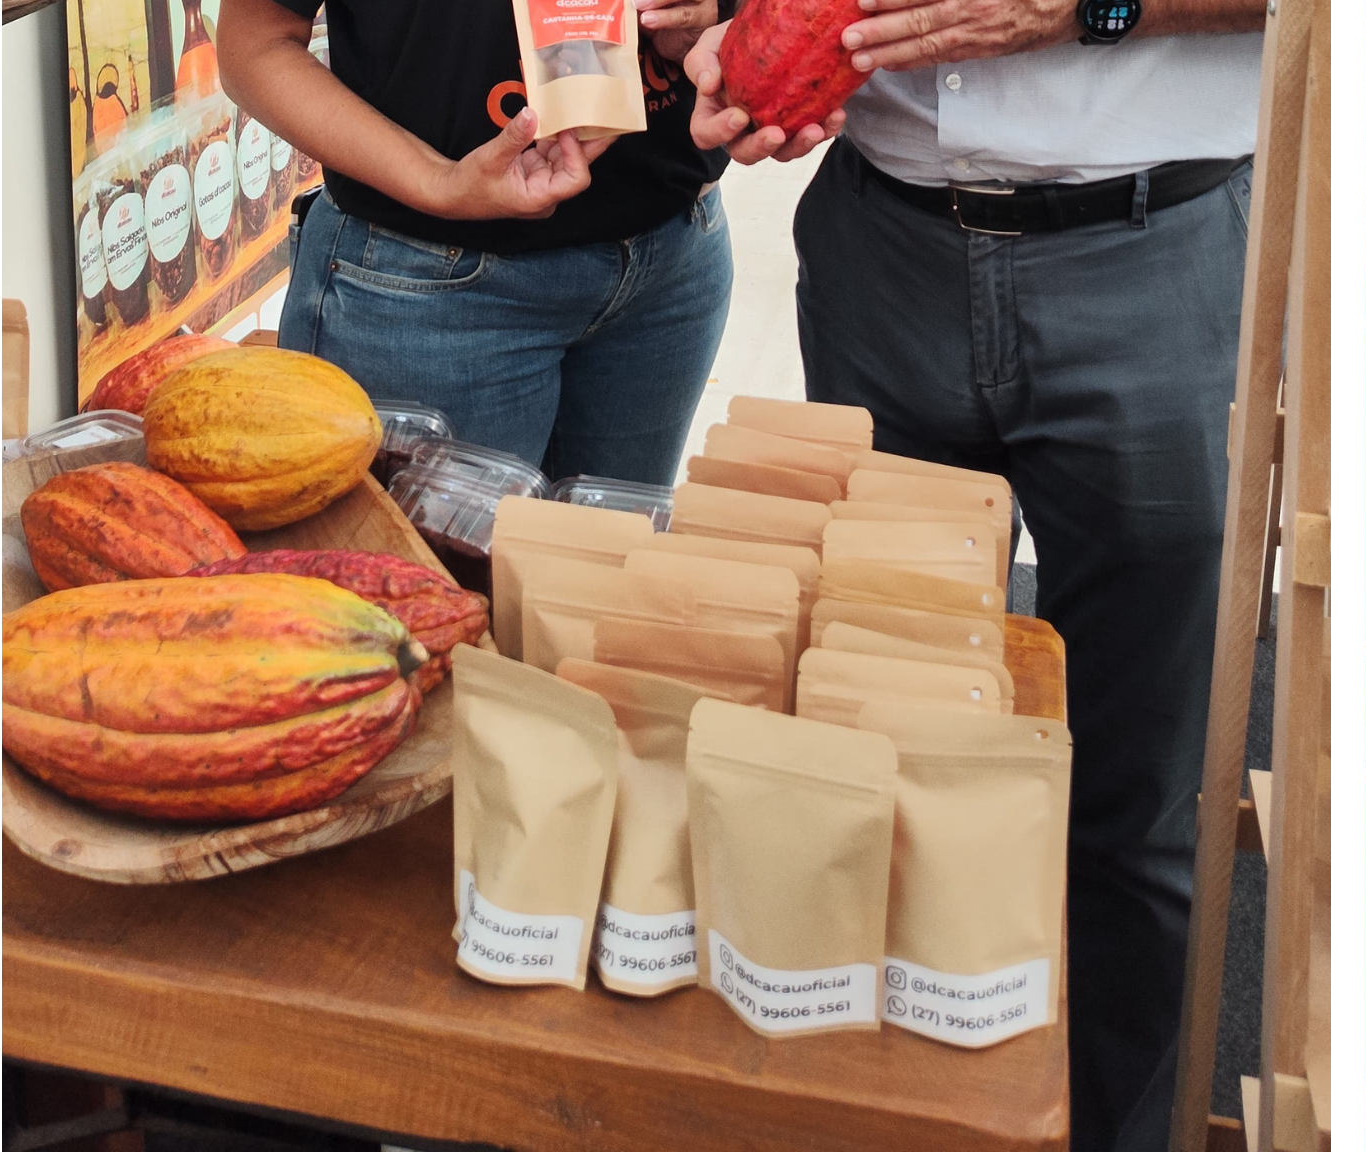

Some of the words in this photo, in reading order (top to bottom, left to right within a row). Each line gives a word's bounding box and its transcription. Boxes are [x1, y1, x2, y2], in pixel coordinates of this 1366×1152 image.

[151, 215, 165, 230] Nibs
[164, 200, 188, 221] Original
[107, 242, 121, 255] Nibs
[599, 913, 696, 941] @dcacauoficia
[470, 938, 554, 967] 99606-5561
[618, 949, 697, 972] 99606-5561
[734, 962, 851, 995] @dcacauoficial
[910, 972, 1028, 1002] @dcacauoficial
[734, 988, 757, 1016] (27)
[759, 999, 852, 1020] 99606-5561
[911, 1003, 942, 1027] (27)
[944, 1002, 1029, 1031] 99606-5561
